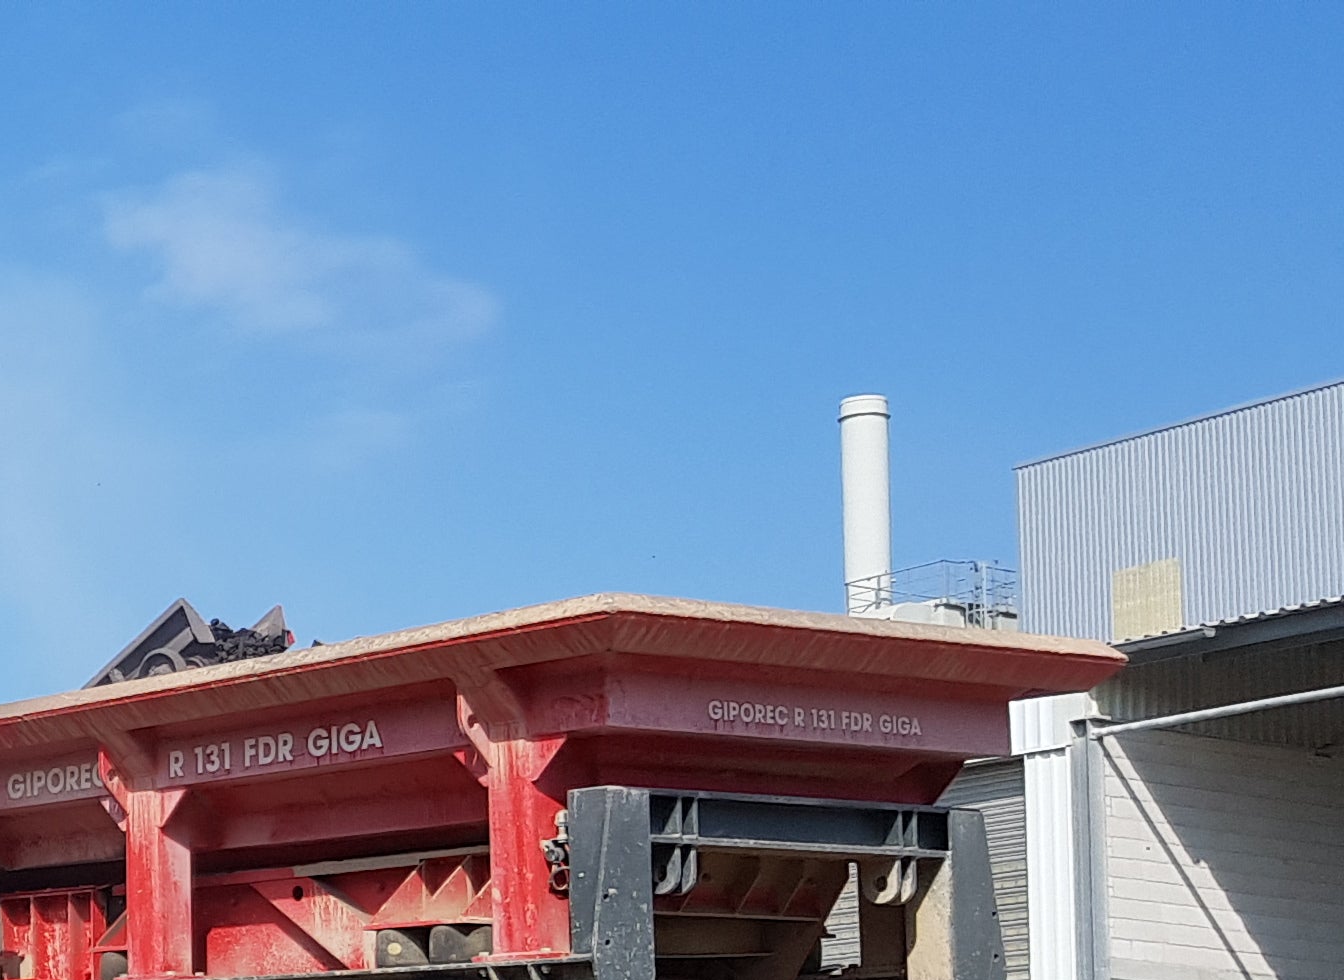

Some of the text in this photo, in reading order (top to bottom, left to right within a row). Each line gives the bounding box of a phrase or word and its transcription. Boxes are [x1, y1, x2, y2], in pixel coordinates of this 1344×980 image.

[708, 700, 922, 736] GIPOREC R 131 FDR GIGA
[169, 750, 184, 778] R
[194, 742, 231, 774] 131
[244, 732, 294, 767] FDR
[307, 720, 383, 757] GIGA
